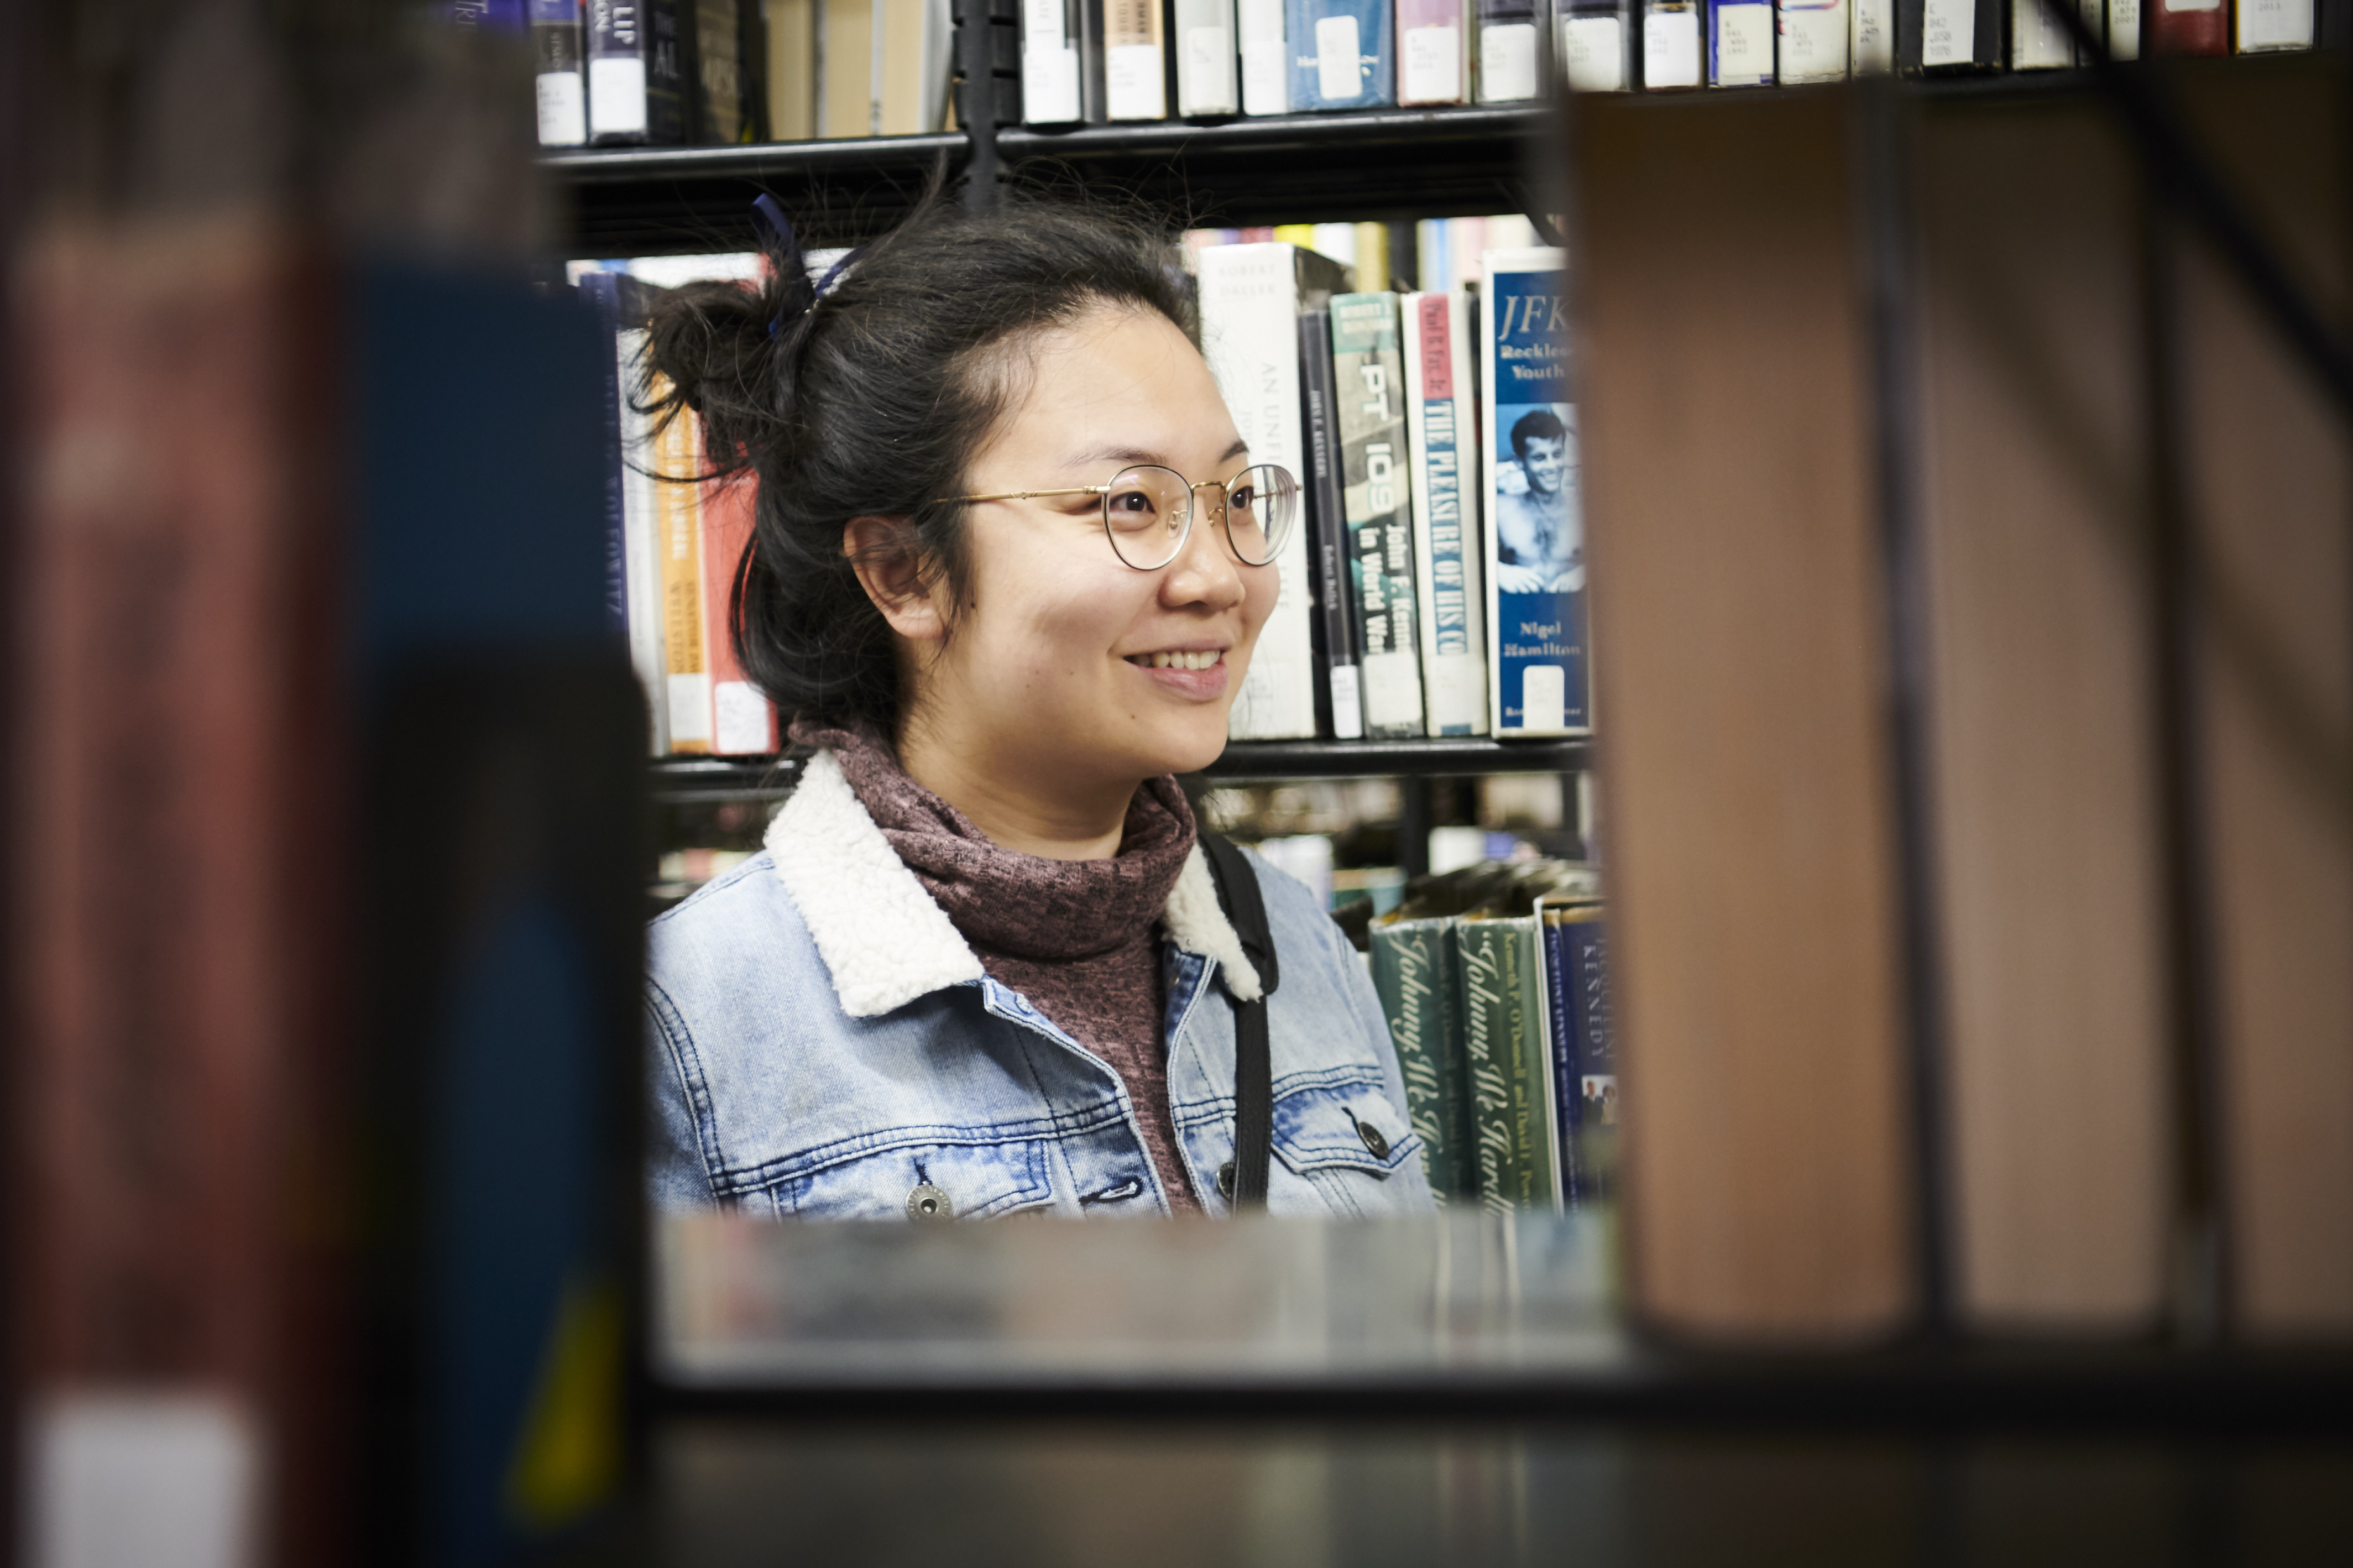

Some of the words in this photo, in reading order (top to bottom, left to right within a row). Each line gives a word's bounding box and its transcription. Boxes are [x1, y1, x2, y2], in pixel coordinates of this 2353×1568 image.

[1497, 295, 1572, 342] JFK
[1512, 364, 1565, 380] Youth
[1359, 364, 1390, 422] PT
[1425, 401, 1455, 445] THE
[1365, 442, 1395, 514] 109
[1428, 451, 1461, 555] PLEASURE
[1358, 527, 1382, 549] in
[1385, 522, 1409, 570] John
[1359, 552, 1386, 612] World
[1389, 574, 1412, 595] F.
[1434, 560, 1463, 587] OF
[1435, 590, 1465, 627] HIS
[1504, 642, 1581, 658] Hamilton
[1520, 621, 1562, 640] Nigel
[1504, 932, 1520, 989] Kenneth
[1508, 990, 1522, 1006] P.
[1583, 944, 1604, 1057] KENNEDY
[1473, 1063, 1510, 1113] We
[1513, 1084, 1530, 1109] and
[1515, 1111, 1533, 1150] David
